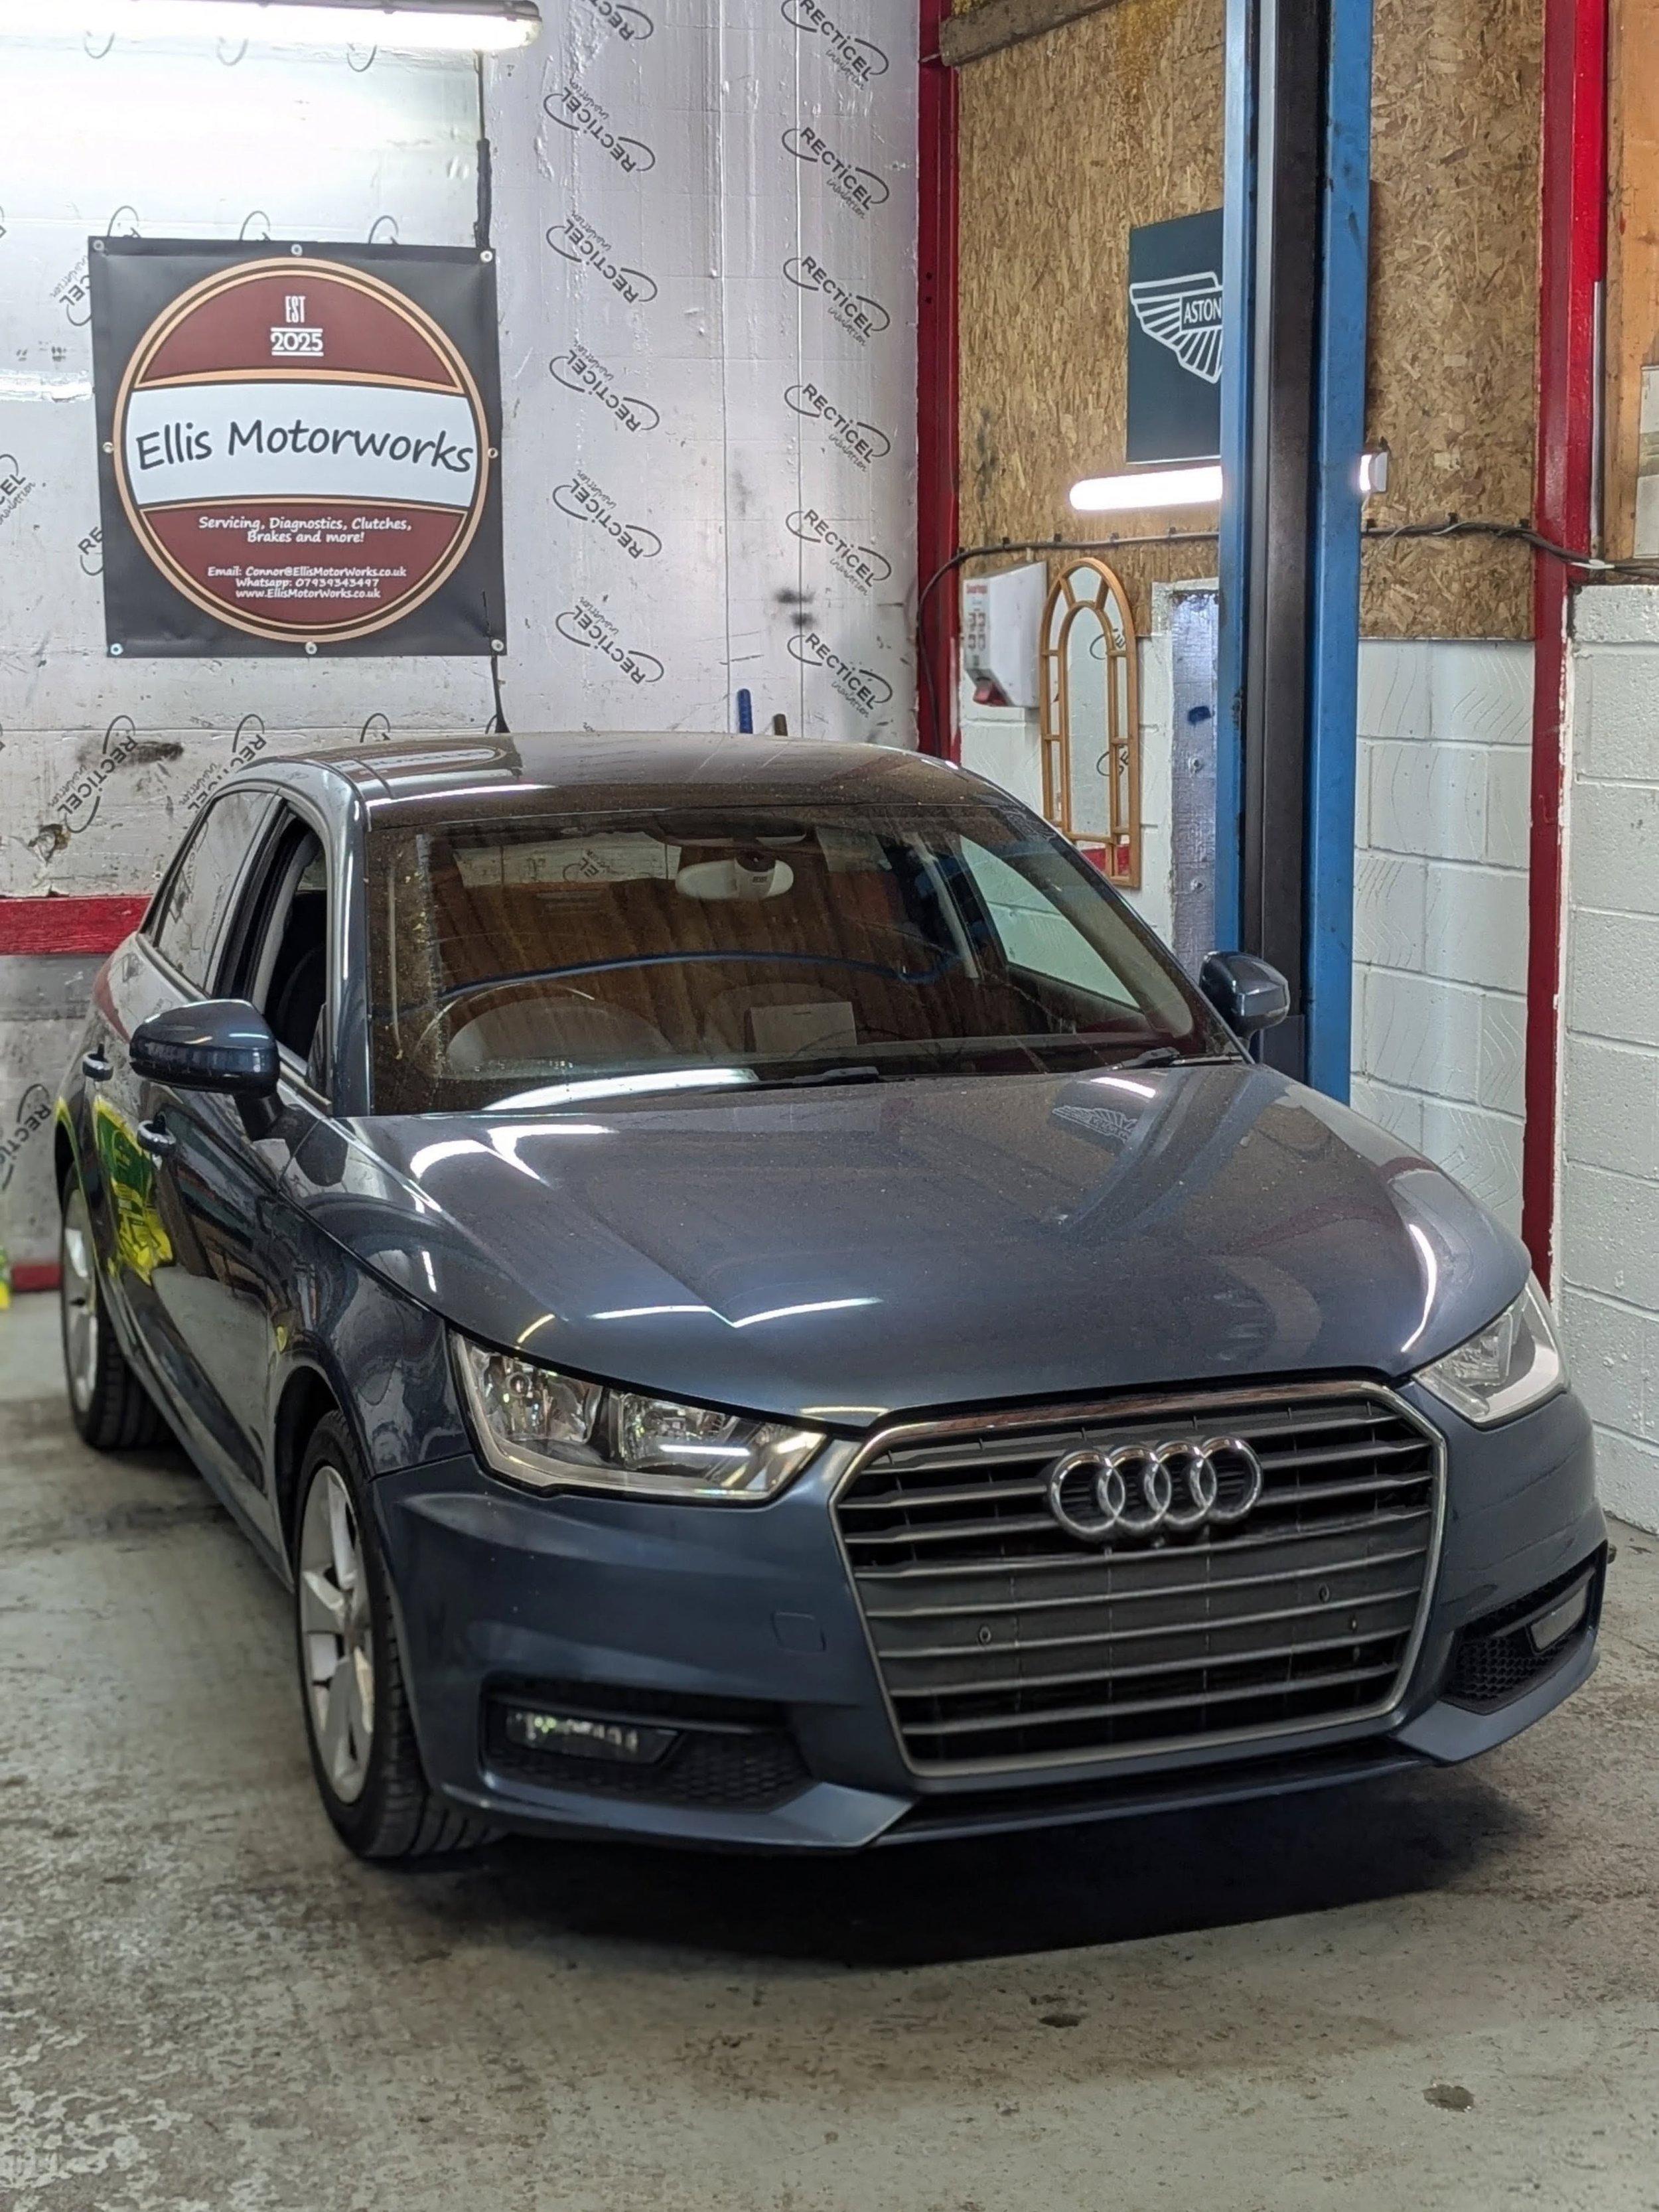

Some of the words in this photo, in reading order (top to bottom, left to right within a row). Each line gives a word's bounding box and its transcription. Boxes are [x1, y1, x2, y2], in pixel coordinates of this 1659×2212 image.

[285, 295, 306, 323] EST
[1183, 297, 1222, 325] ASTON
[270, 332, 323, 352] 2025
[136, 422, 212, 470] Ellis
[228, 419, 474, 473] Motorworks
[198, 516, 265, 532] Servicing,
[269, 516, 347, 532] Diagnostics,
[352, 516, 412, 531] Clutches,
[247, 530, 292, 542] Brakes
[295, 530, 322, 542] and
[326, 532, 364, 543] more!
[207, 566, 242, 577] Email:
[246, 565, 407, 577] Connor@EllisMotorWorks.co.uk
[235, 577, 292, 589] Whatsapp:
[295, 578, 380, 587] 07939343497
[235, 588, 381, 598] www.EllisMotorWorks.co.uk
